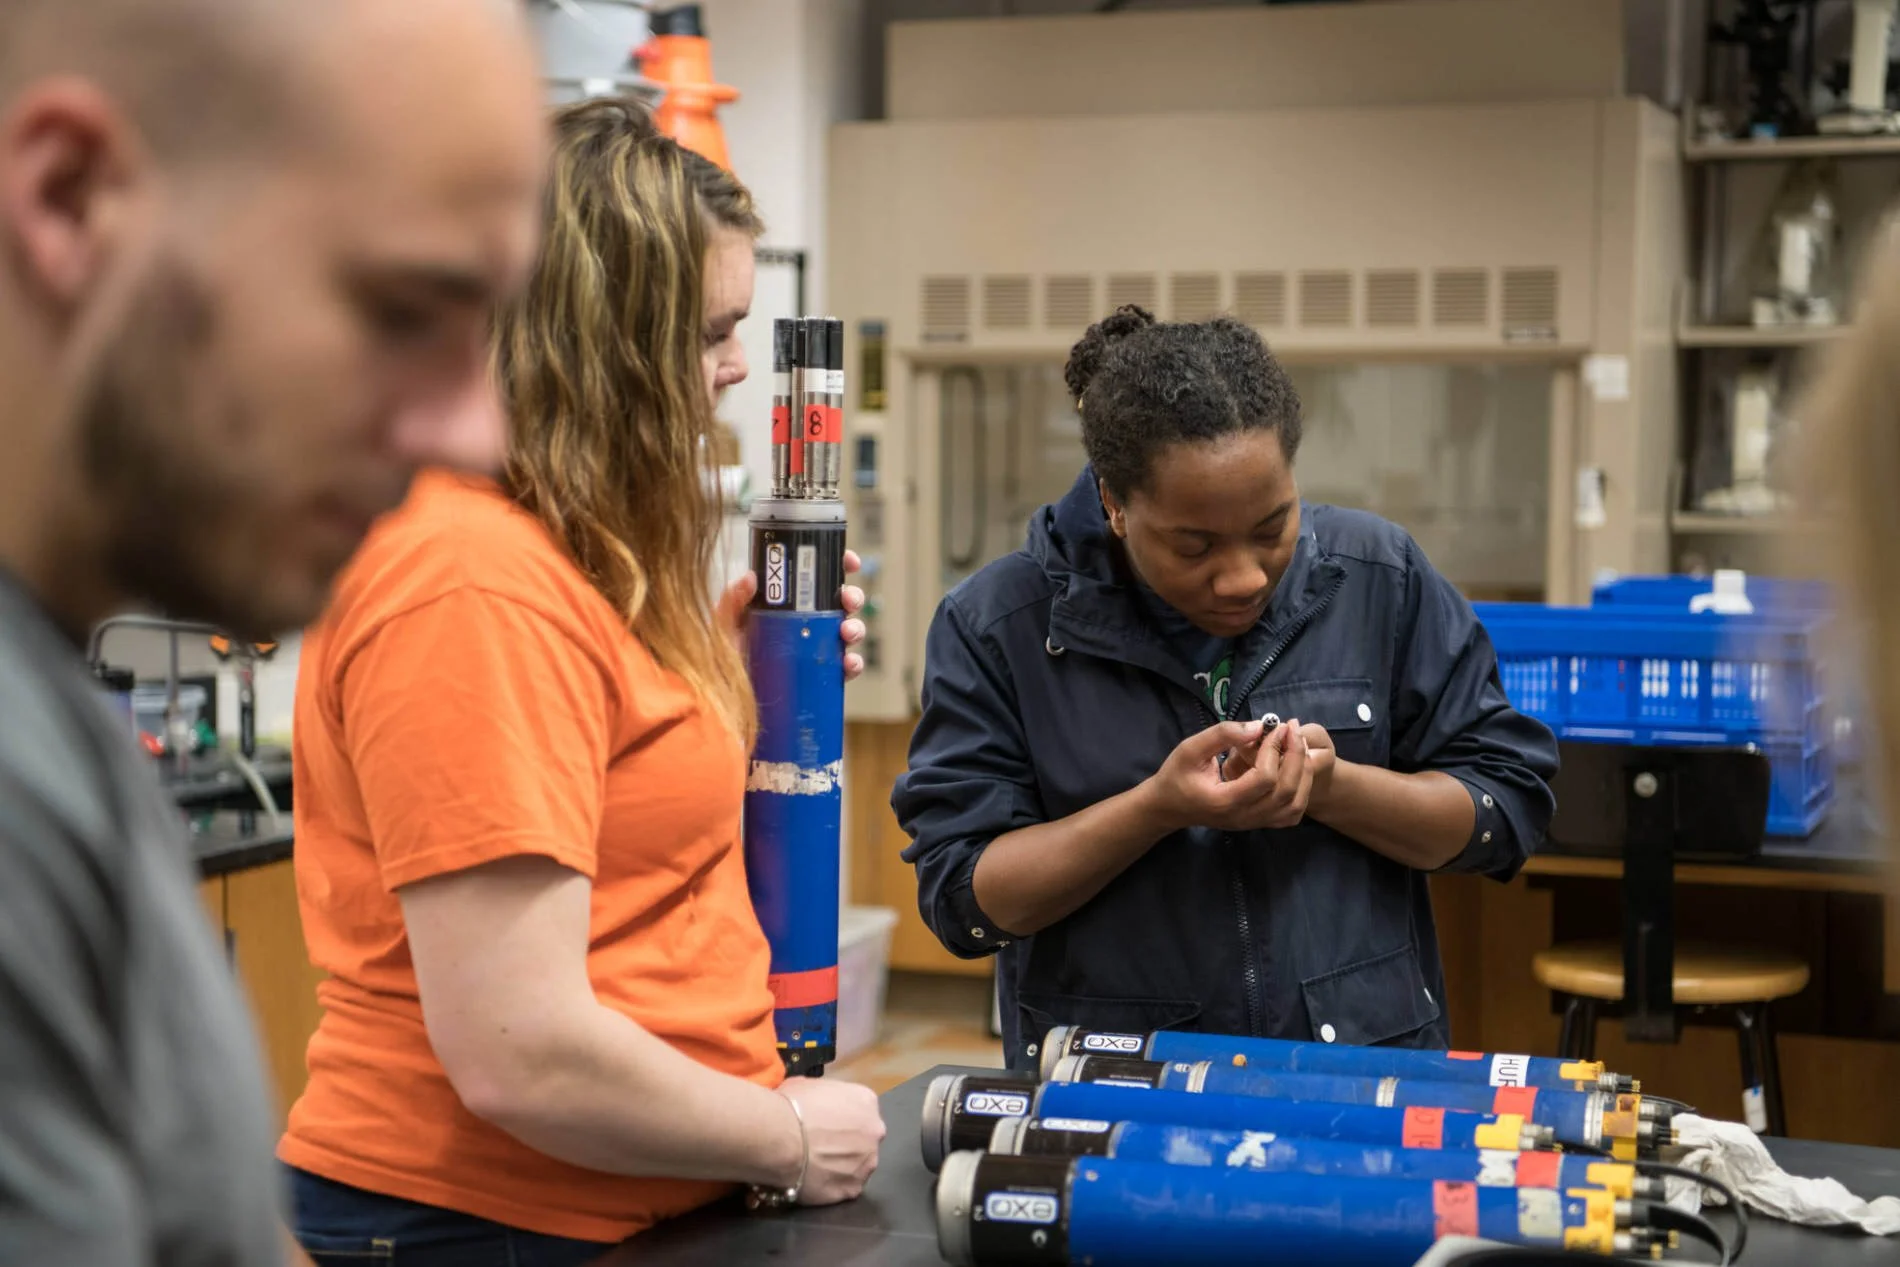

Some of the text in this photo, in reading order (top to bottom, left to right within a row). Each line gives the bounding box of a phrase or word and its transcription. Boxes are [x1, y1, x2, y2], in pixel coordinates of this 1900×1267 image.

[809, 410, 823, 436] 8
[767, 545, 783, 601] exo
[1086, 1036, 1139, 1051] exo
[969, 1096, 1025, 1114] exo
